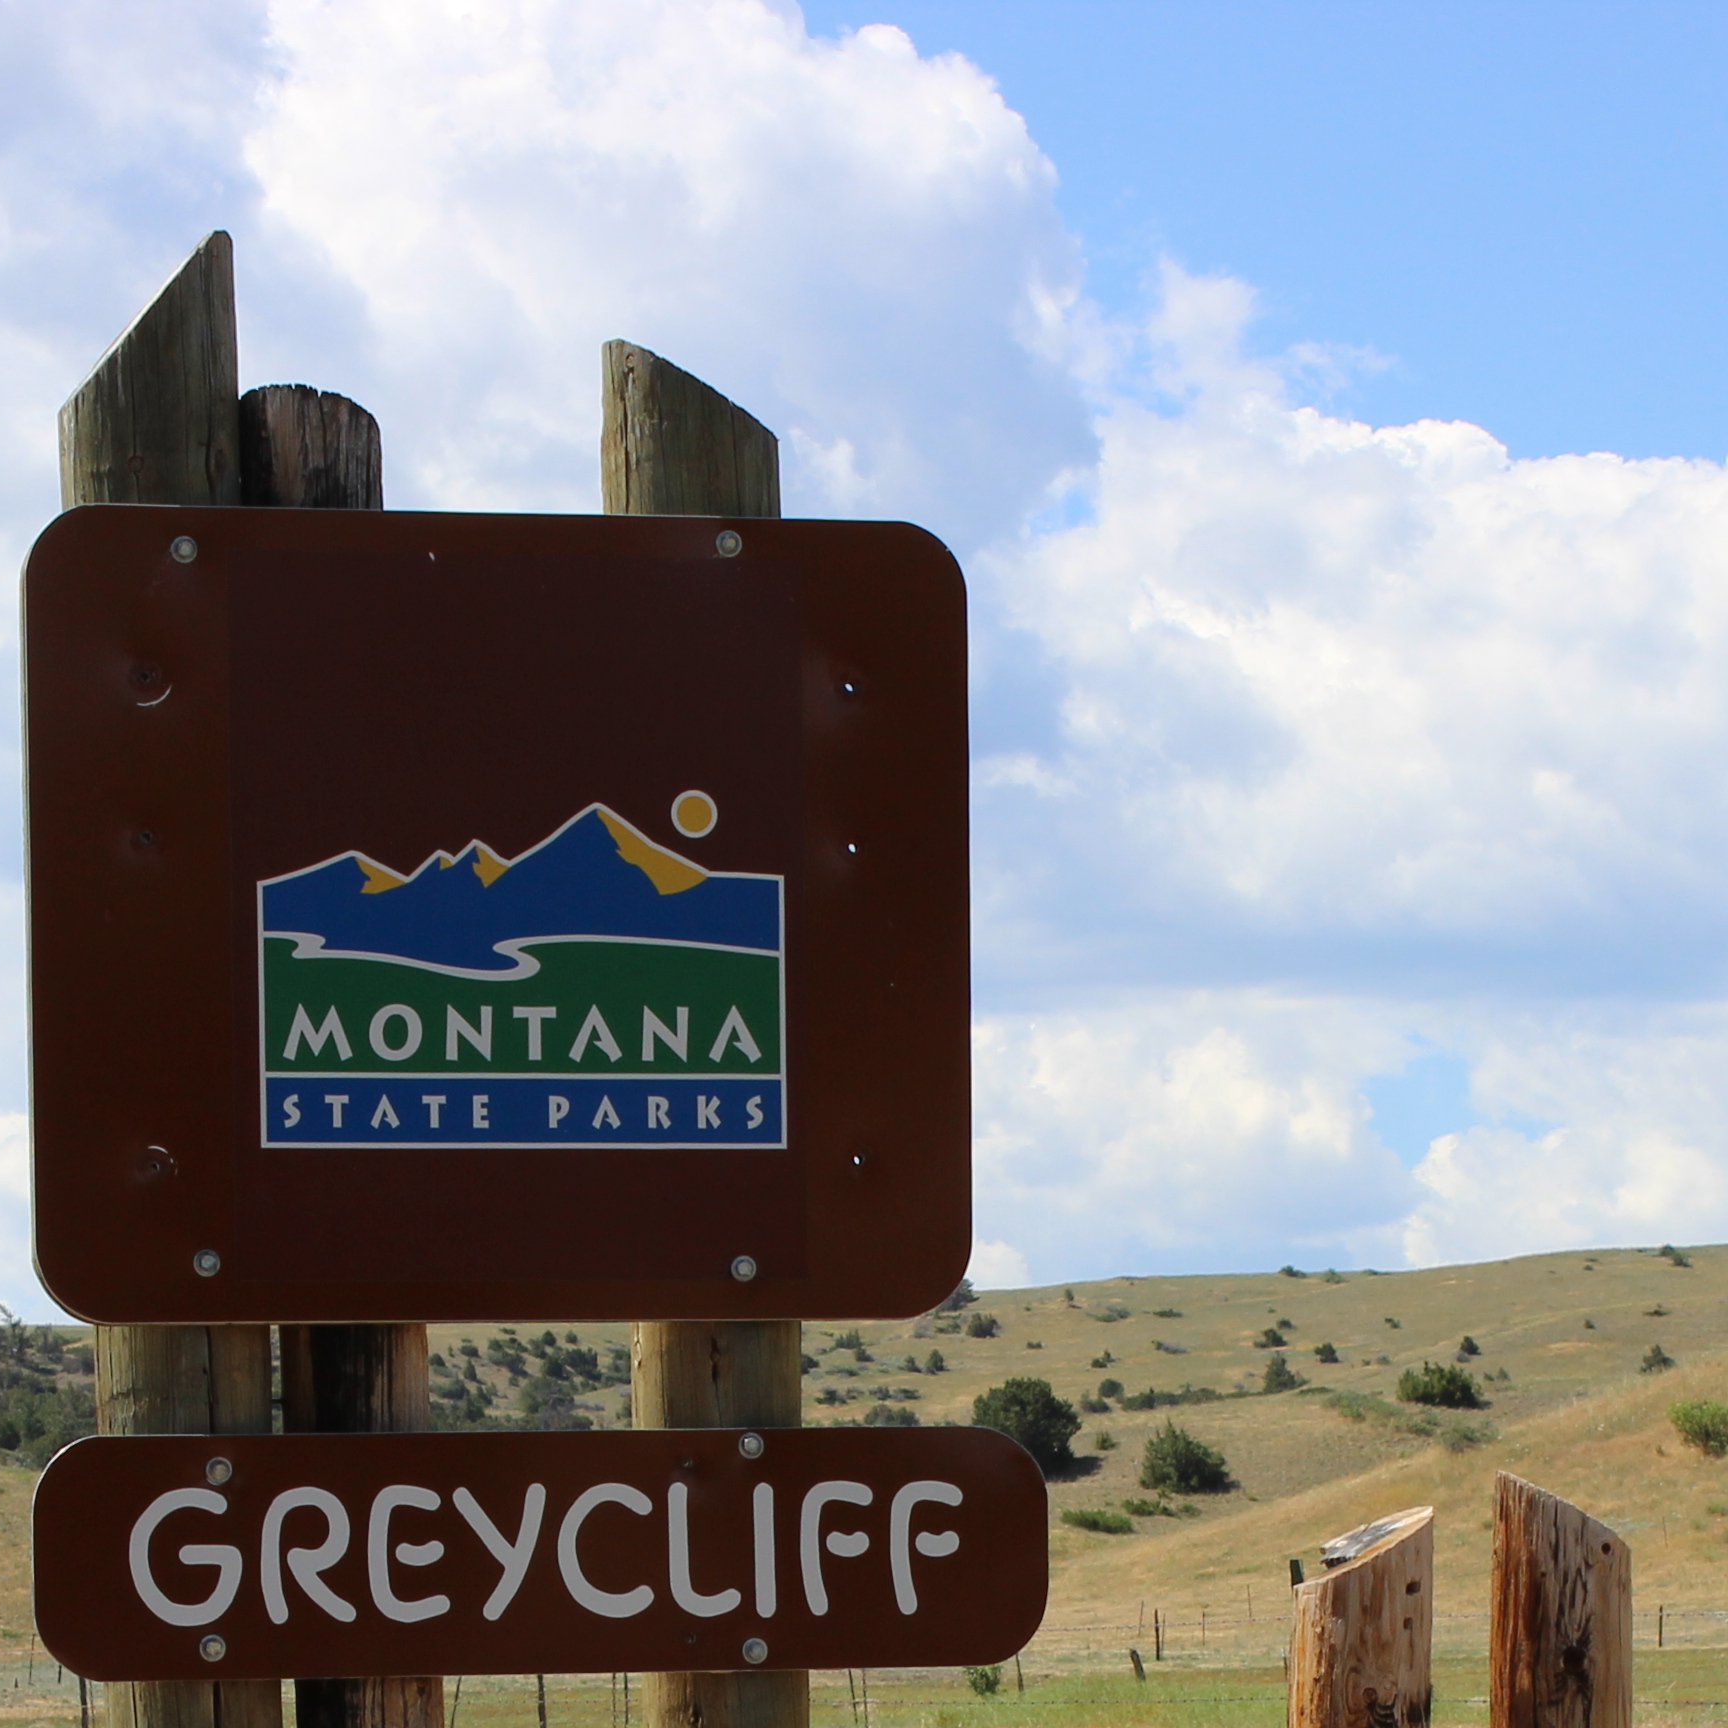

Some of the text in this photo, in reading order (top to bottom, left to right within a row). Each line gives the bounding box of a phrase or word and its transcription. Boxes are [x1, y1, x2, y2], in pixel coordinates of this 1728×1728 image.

[282, 1003, 762, 1062] MONTANA
[282, 1094, 764, 1129] STATE PARKS
[129, 1480, 964, 1627] GREYCLIFF
